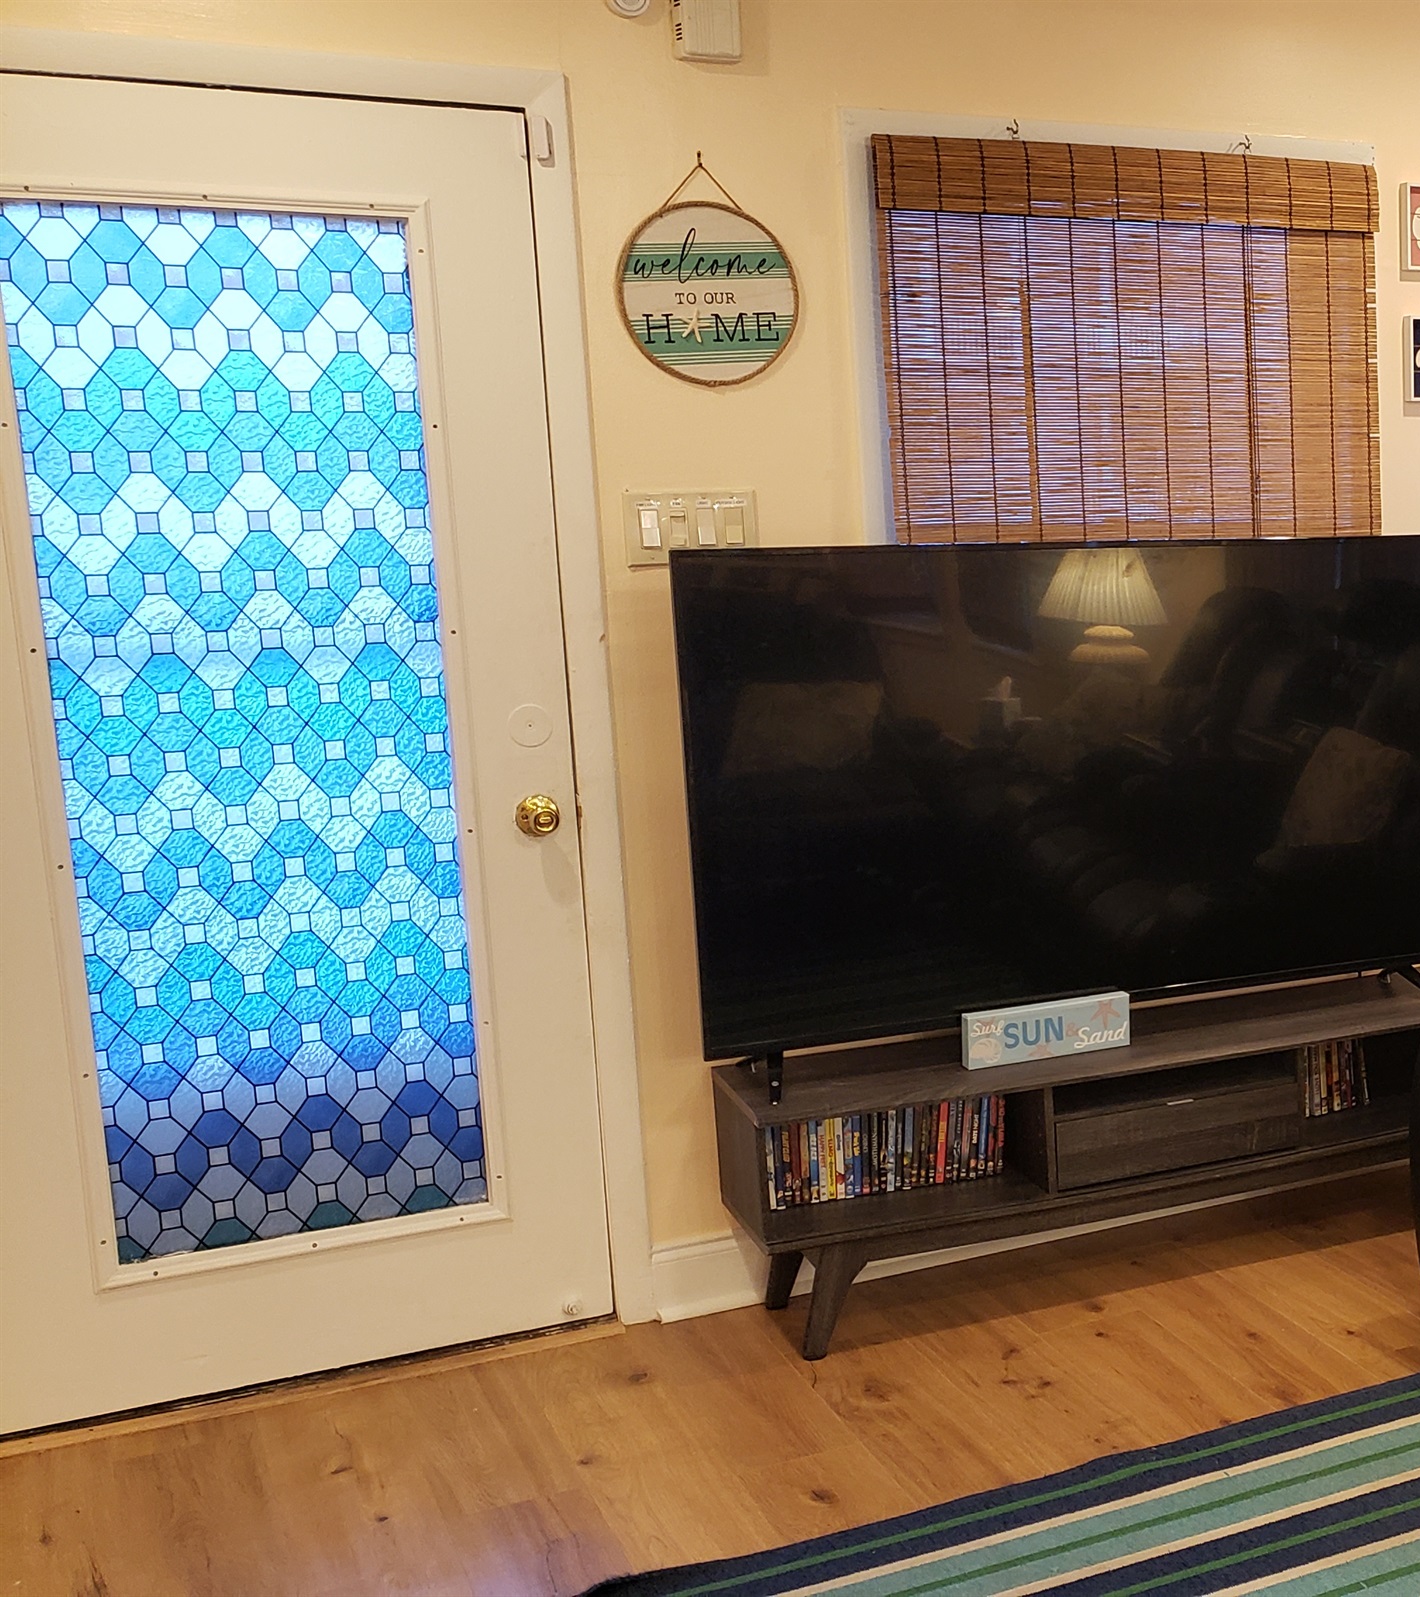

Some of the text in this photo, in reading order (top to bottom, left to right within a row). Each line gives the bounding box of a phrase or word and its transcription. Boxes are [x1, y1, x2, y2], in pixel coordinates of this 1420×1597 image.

[633, 228, 776, 283] welcome
[675, 292, 737, 305] TO OUR
[642, 312, 780, 344] HME
[970, 1020, 1005, 1037] Surf
[1004, 1016, 1064, 1049] SUN
[1074, 1021, 1128, 1049] Sand
